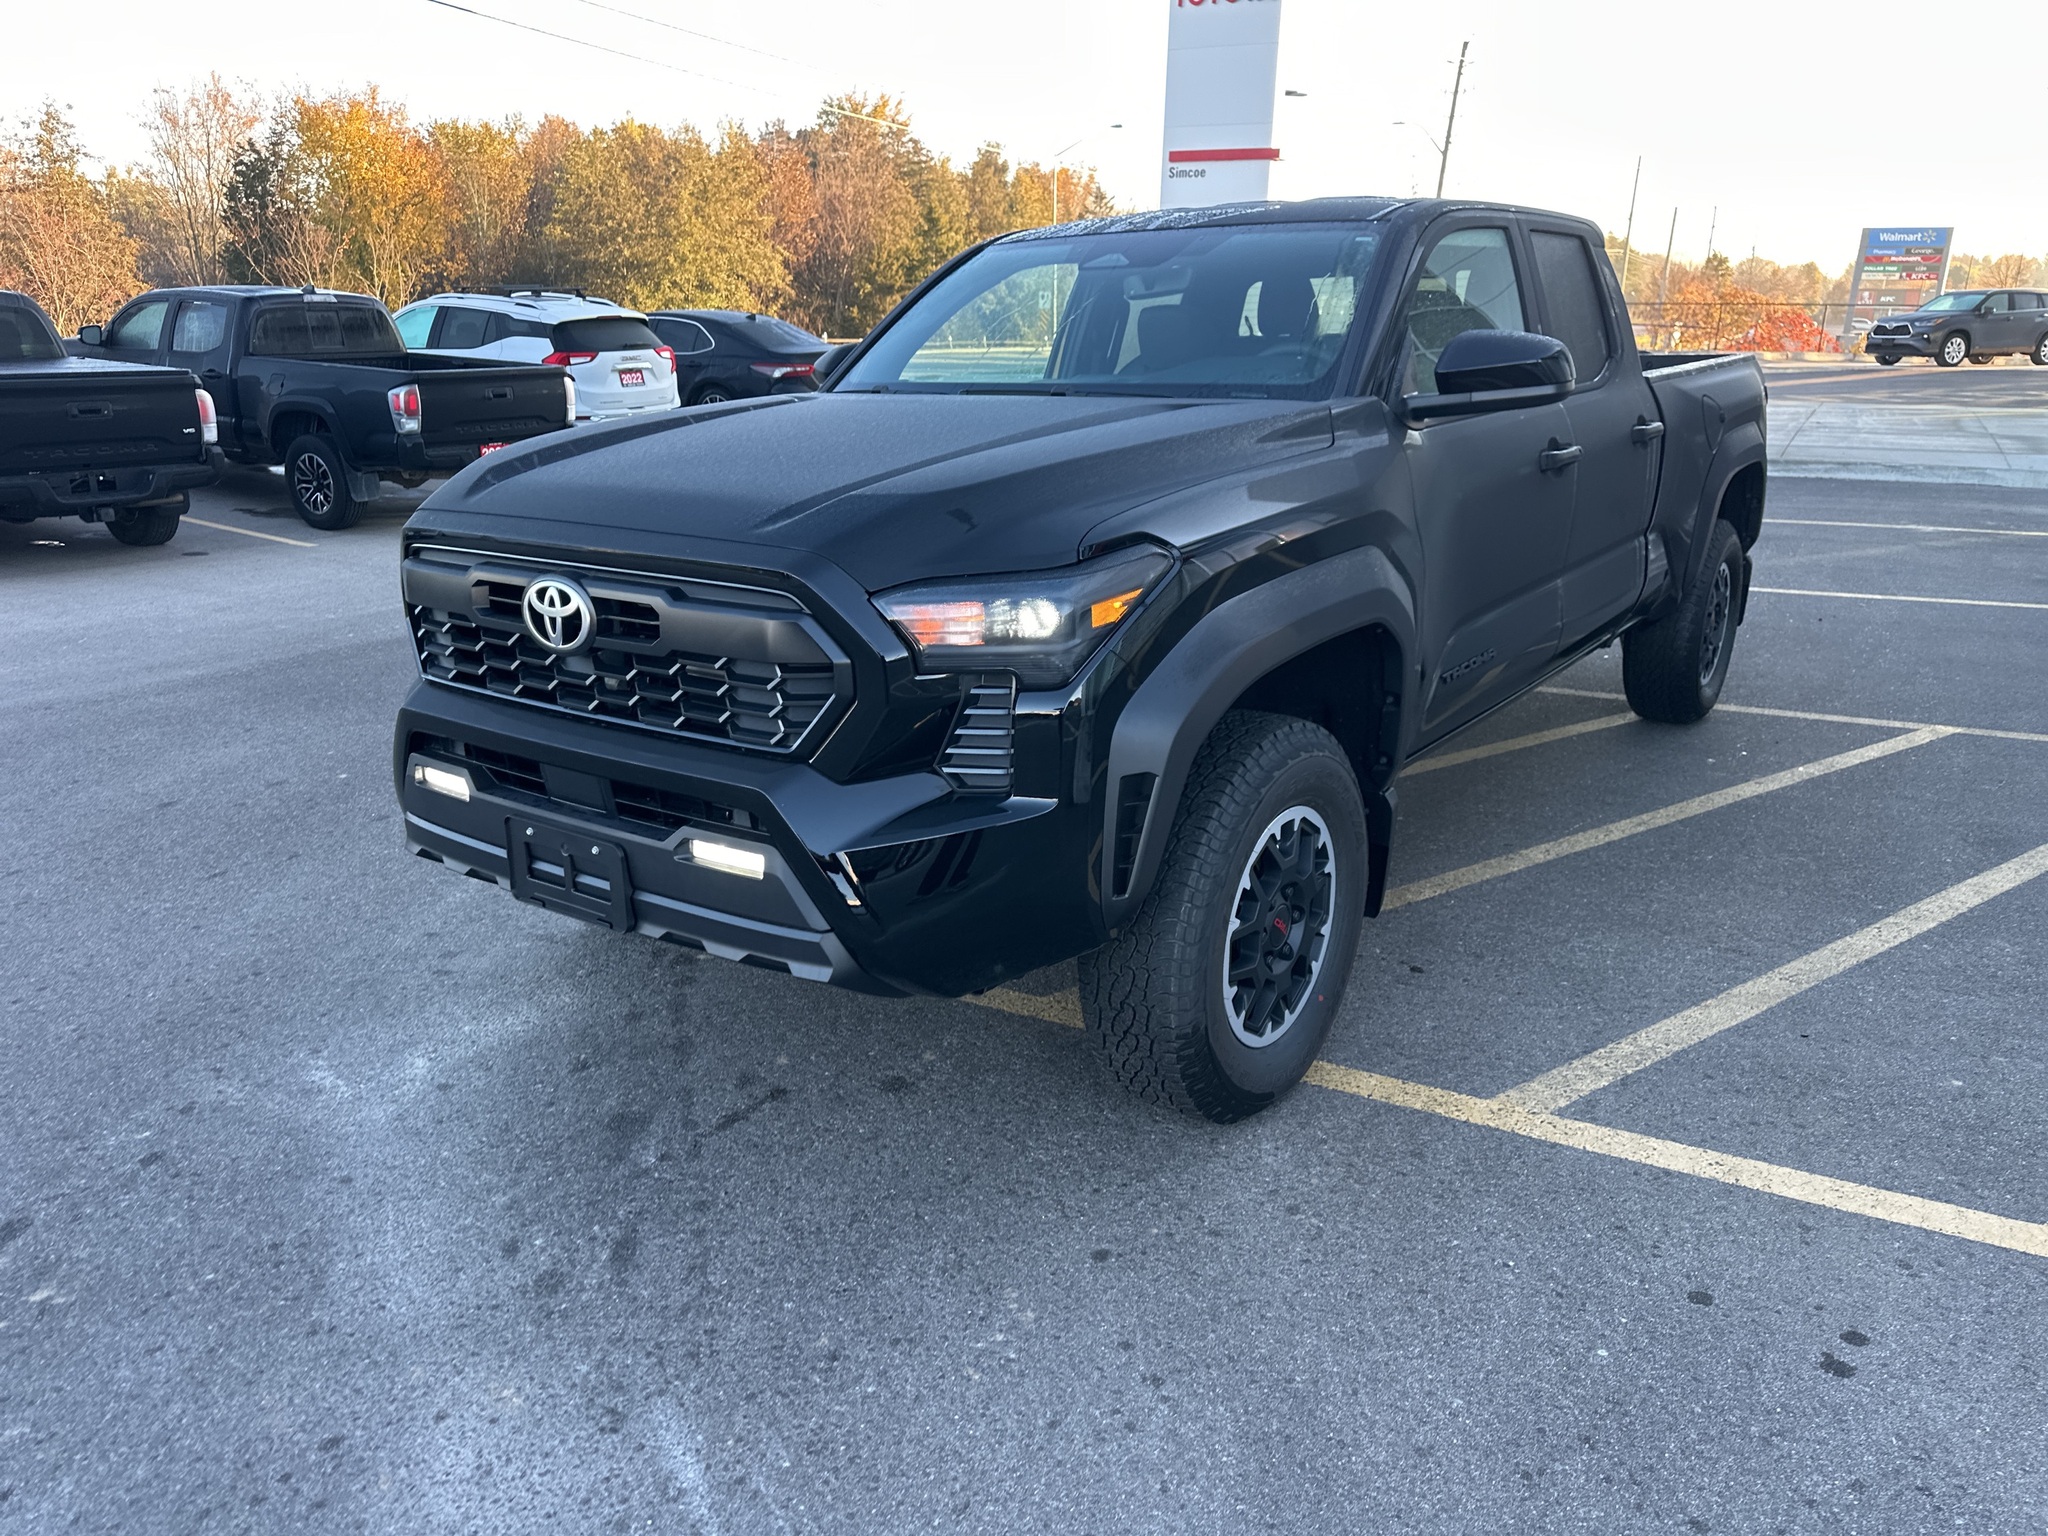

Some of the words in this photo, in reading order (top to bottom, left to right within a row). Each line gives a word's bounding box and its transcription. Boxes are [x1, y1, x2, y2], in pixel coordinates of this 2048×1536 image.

[1168, 166, 1206, 179] Simcoe
[1879, 232, 1922, 242] Walmart
[621, 372, 643, 384] 2022
[455, 420, 541, 434] TACOMA
[24, 443, 159, 459] TACOMA
[1440, 647, 1497, 686] TACOMA
